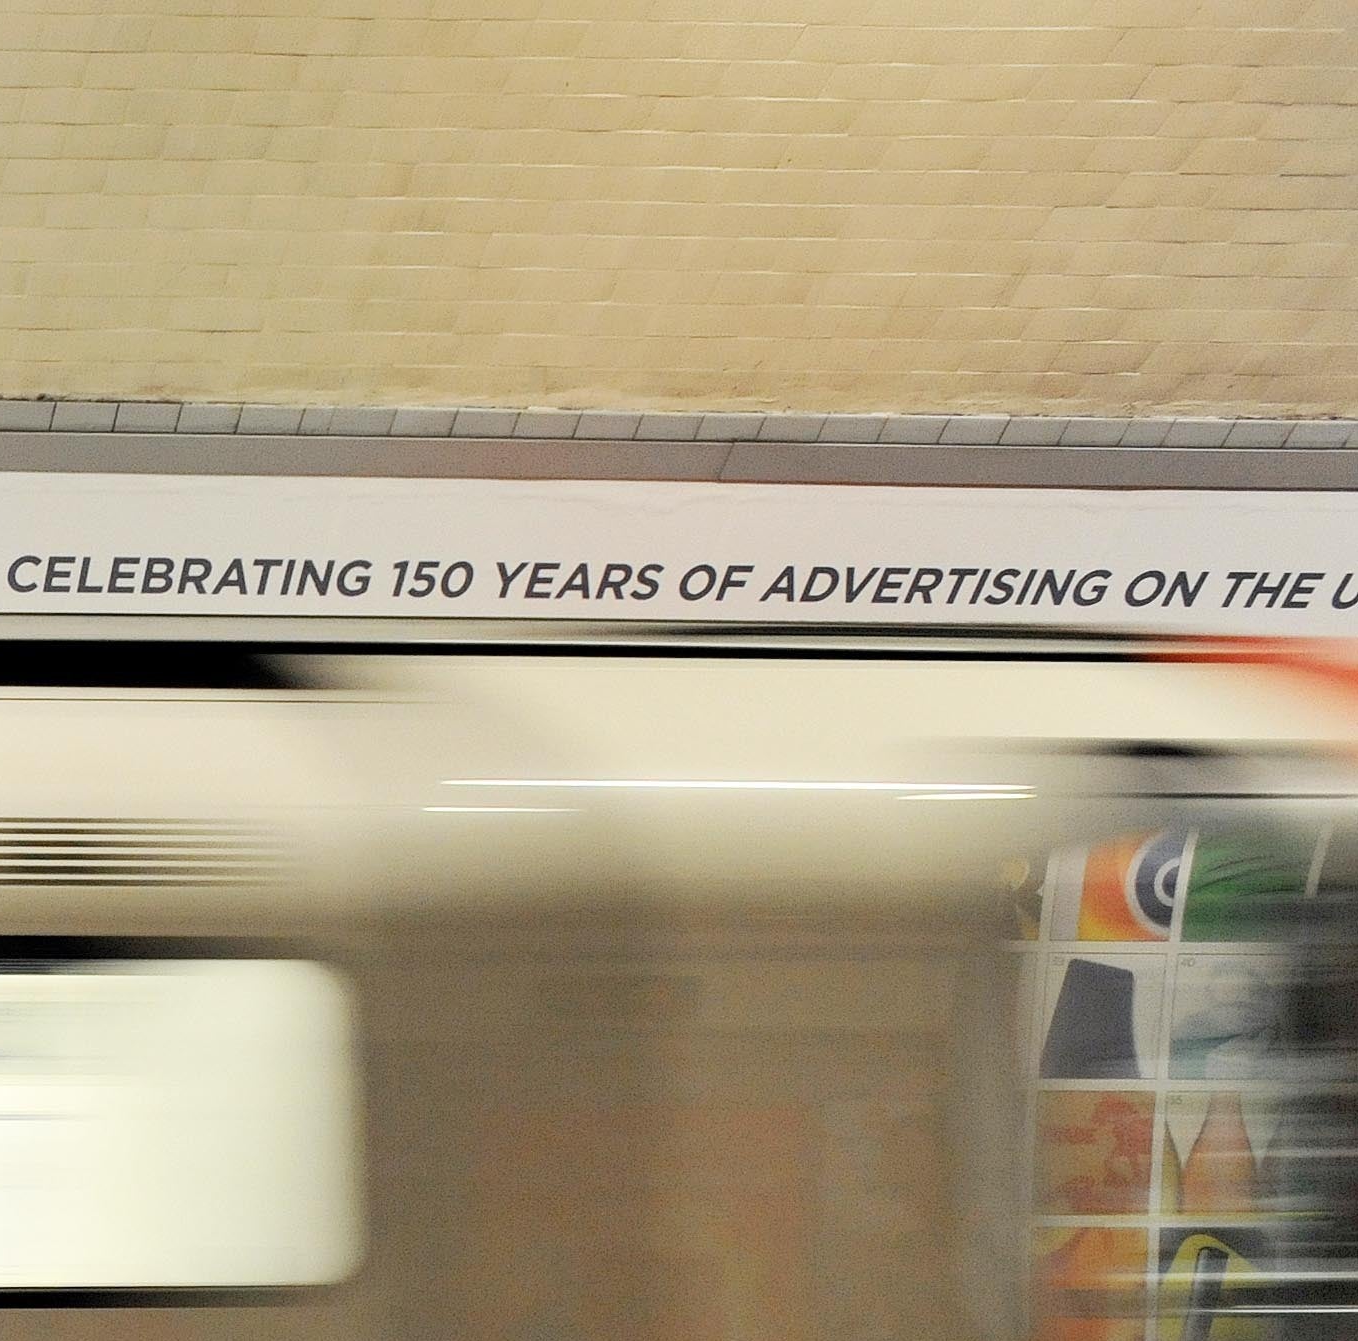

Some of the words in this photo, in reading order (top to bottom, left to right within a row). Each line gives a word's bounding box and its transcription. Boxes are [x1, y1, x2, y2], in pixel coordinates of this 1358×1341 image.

[7, 555, 374, 597] CELEBRATING
[392, 560, 475, 599] 150
[496, 561, 665, 601] YEARS
[678, 563, 757, 603] OF
[758, 565, 1113, 607] ADVERTISING
[1124, 570, 1210, 608] ON
[1221, 571, 1327, 609] THE
